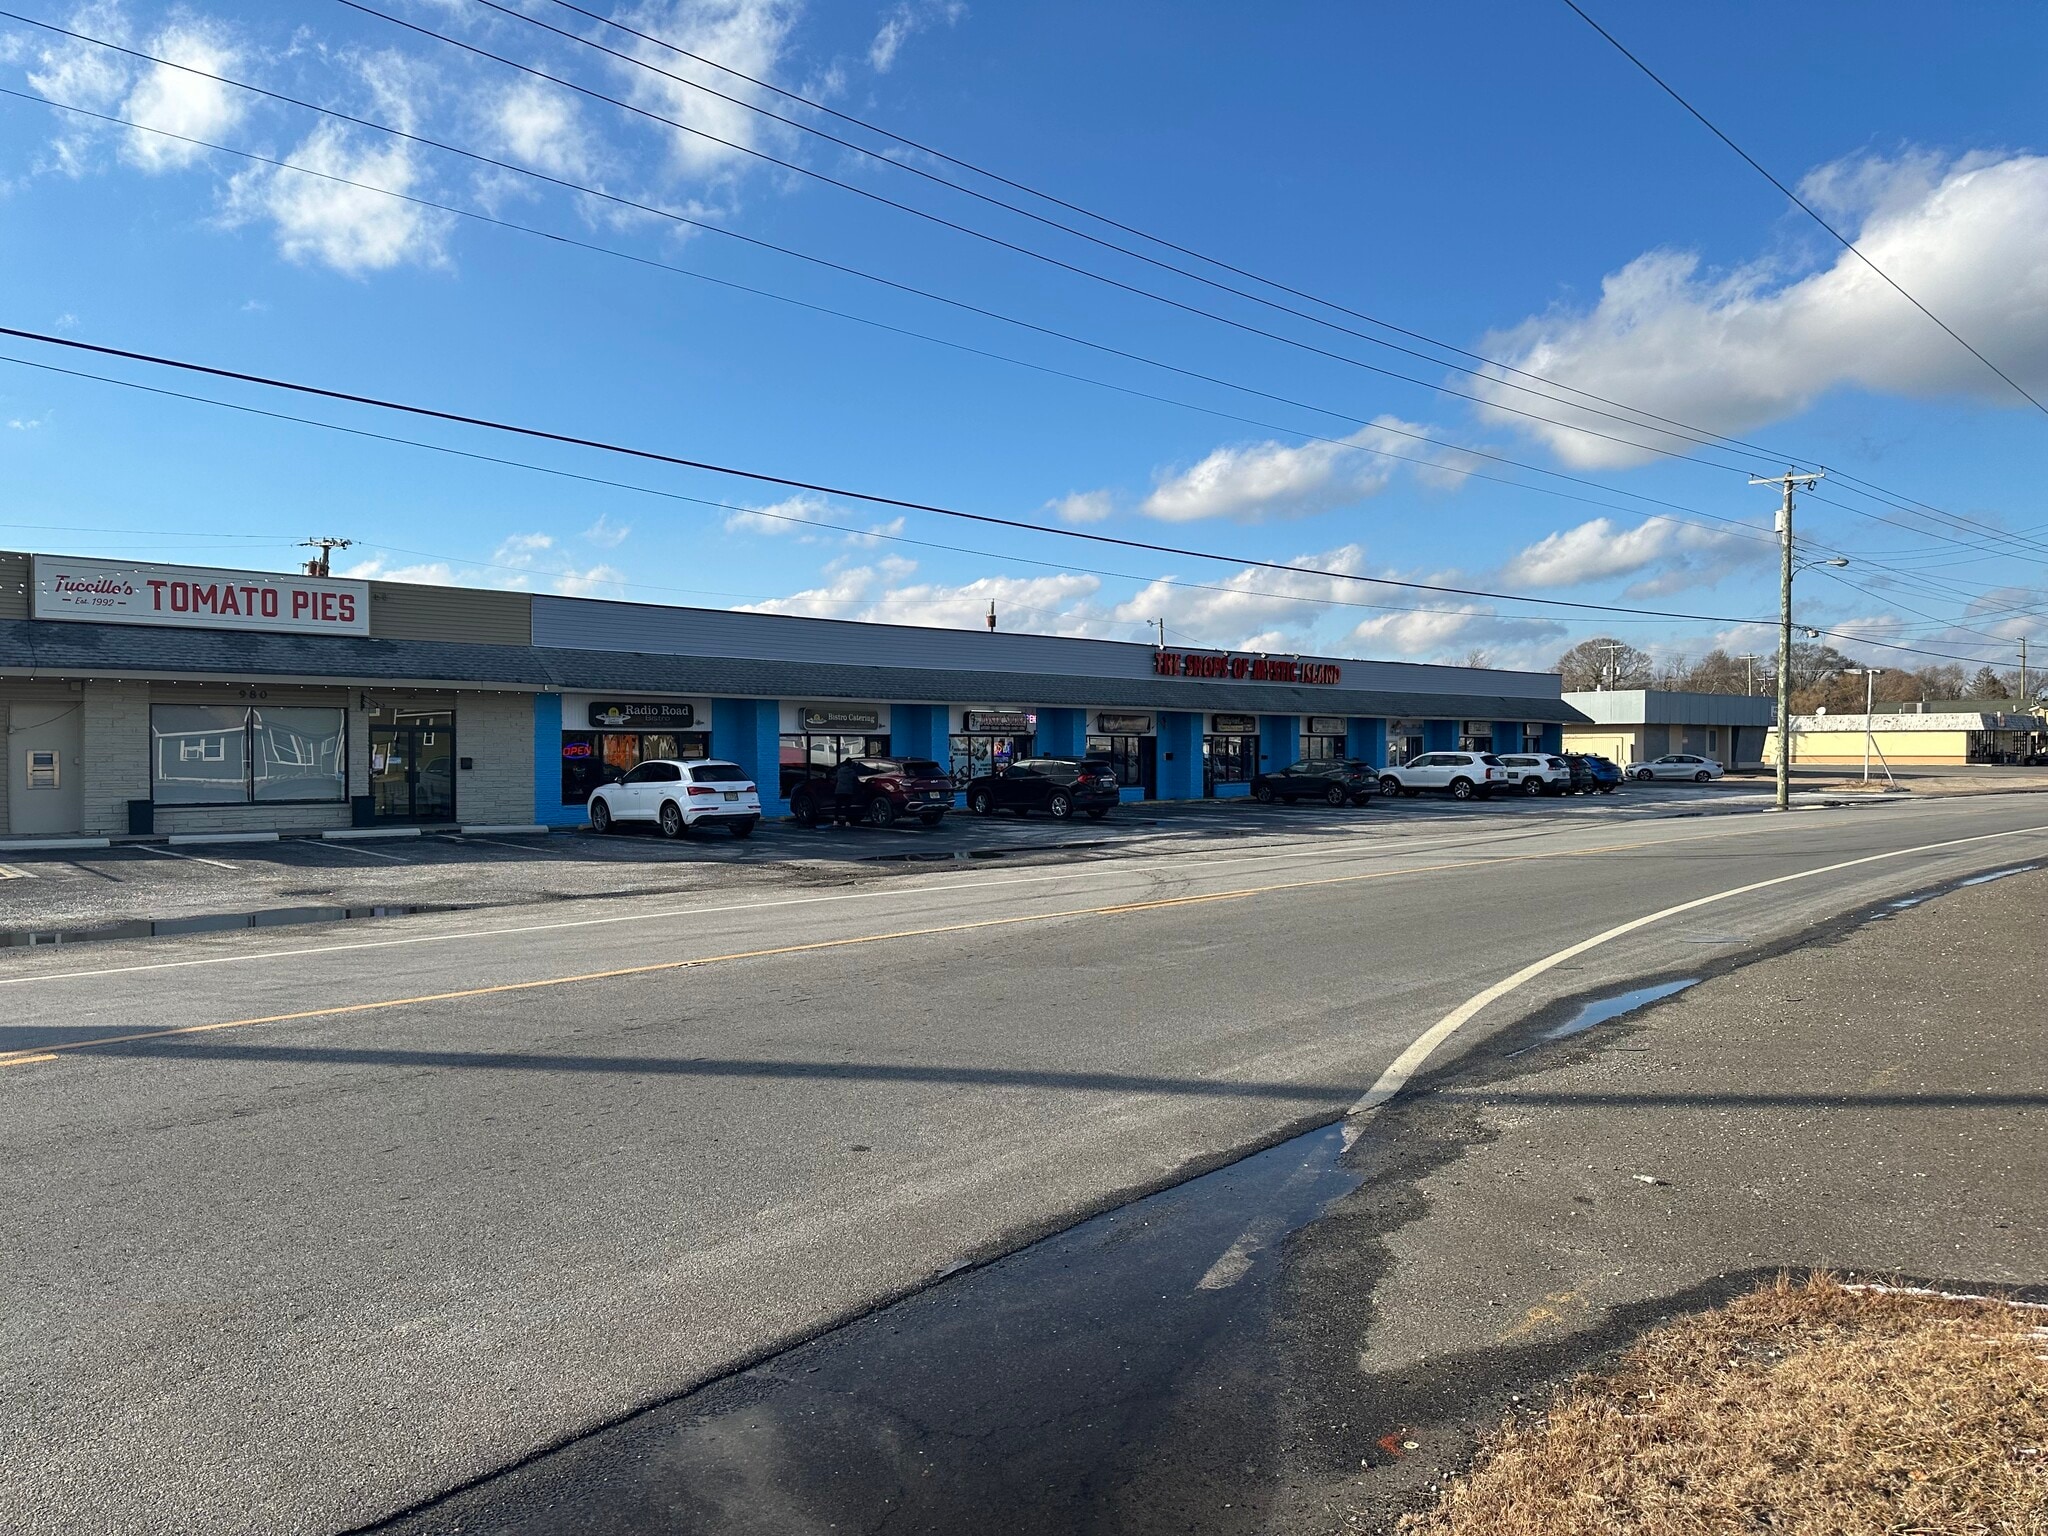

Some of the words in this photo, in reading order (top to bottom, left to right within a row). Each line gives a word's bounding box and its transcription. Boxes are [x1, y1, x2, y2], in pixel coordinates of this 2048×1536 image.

[55, 574, 133, 596] Tuccillo's
[75, 597, 90, 605] Est.
[92, 598, 115, 607] 1992
[146, 579, 278, 618] TOMATO
[292, 590, 355, 622] PIES
[1155, 652, 1181, 676] THE
[1185, 654, 1228, 679] SHOPS
[1232, 658, 1249, 679] OF
[1252, 660, 1297, 682] MYSTIC
[1301, 662, 1341, 685] ISLAND
[239, 690, 268, 699] 980
[625, 704, 659, 716] Radio
[661, 705, 689, 716] Road
[828, 713, 847, 721] Bistro
[848, 714, 875, 724] Catering
[563, 745, 592, 756] OPEN
